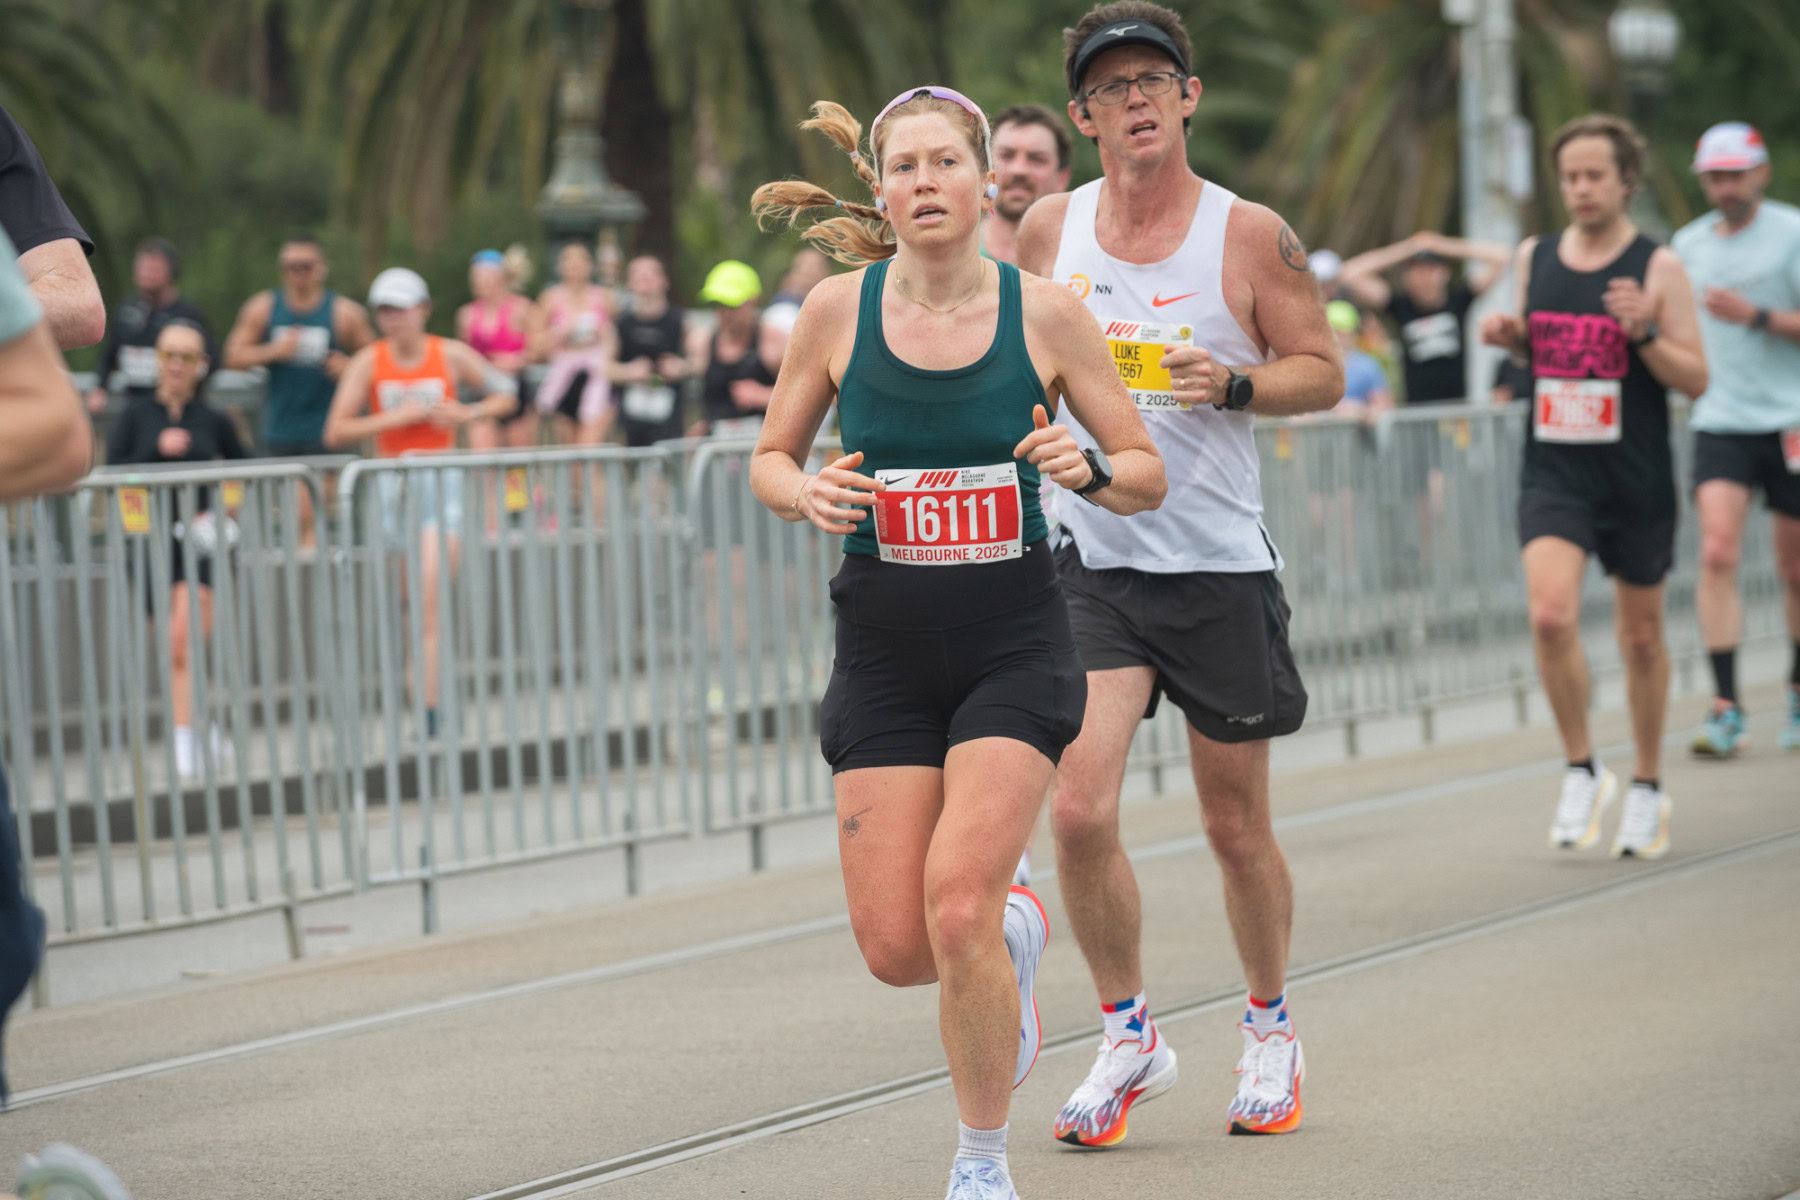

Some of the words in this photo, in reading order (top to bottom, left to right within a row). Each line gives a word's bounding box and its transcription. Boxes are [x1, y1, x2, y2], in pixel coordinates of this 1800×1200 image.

[1095, 284, 1112, 295] NN
[1115, 343, 1141, 361] LUKE
[1115, 361, 1143, 379] 1567
[899, 491, 998, 543] 16111
[890, 547, 970, 562] MELBOURNE
[974, 544, 1008, 560] 2025
